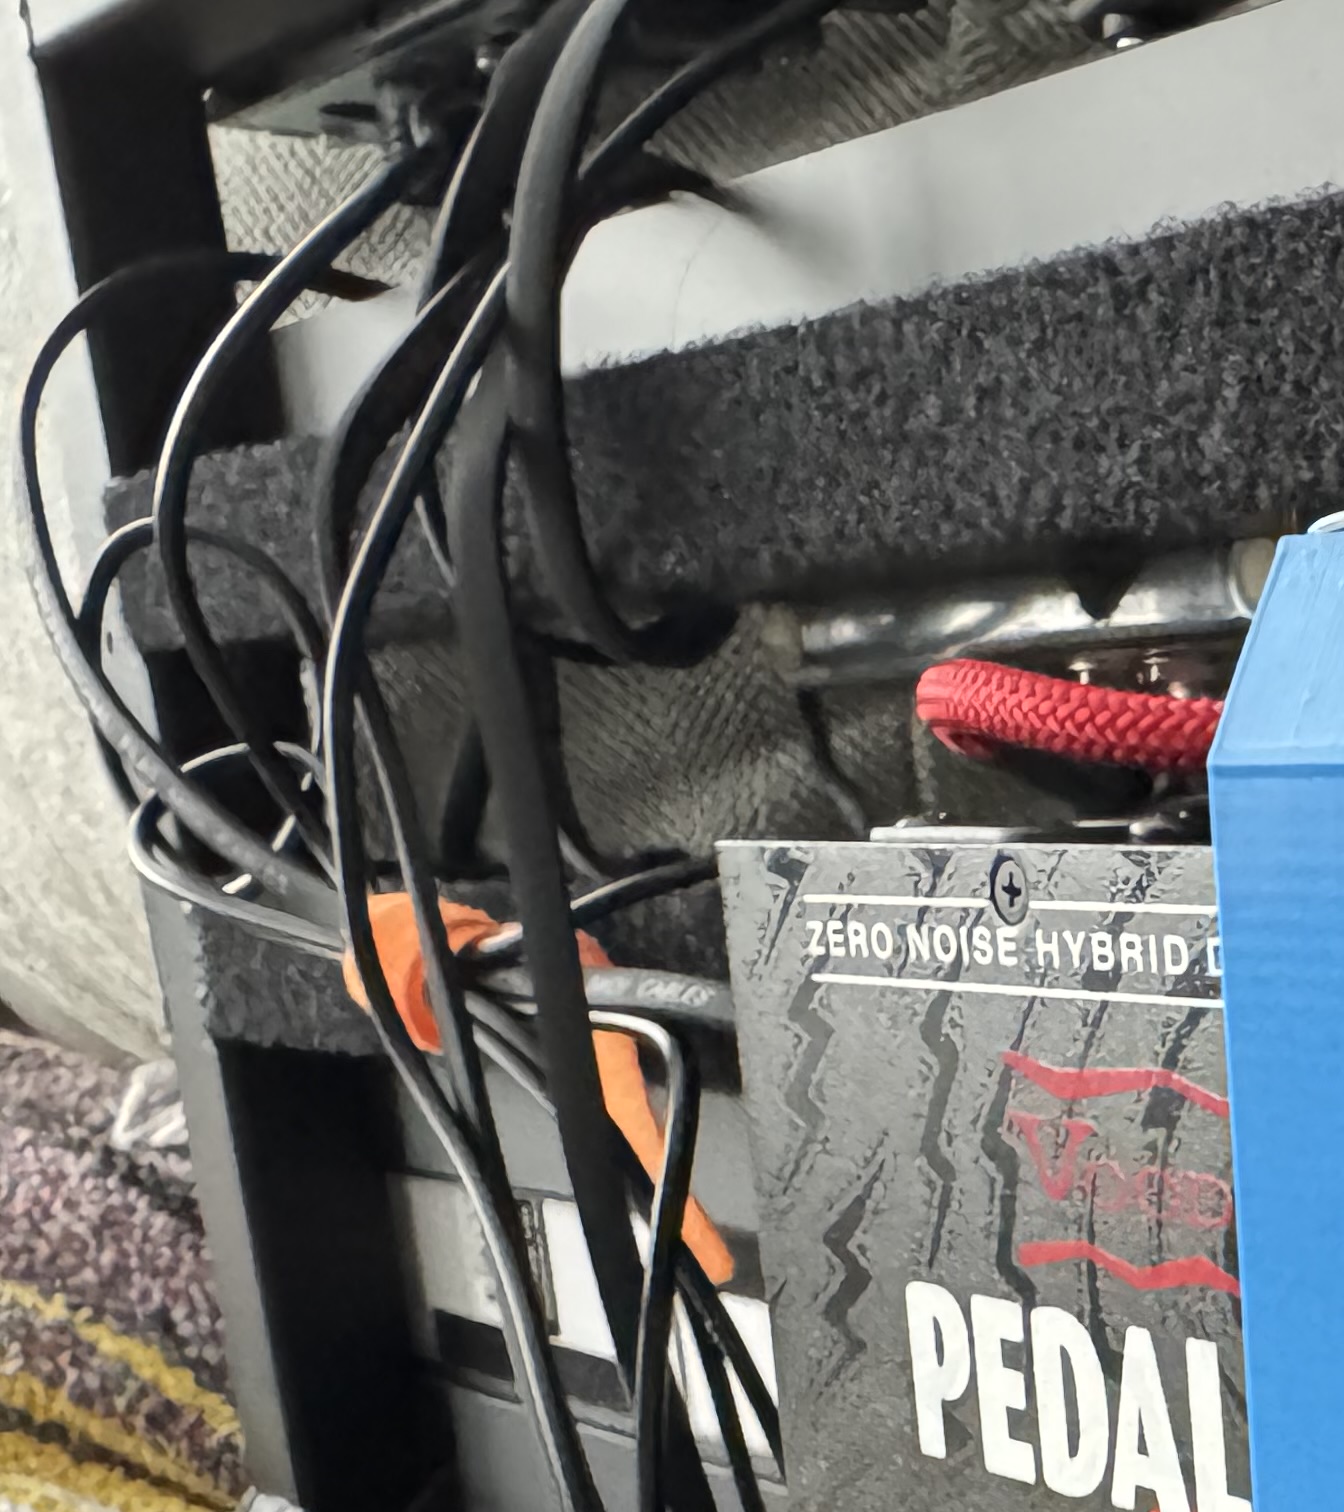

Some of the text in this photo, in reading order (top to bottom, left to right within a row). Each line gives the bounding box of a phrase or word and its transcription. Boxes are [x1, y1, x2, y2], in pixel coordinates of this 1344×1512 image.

[805, 920, 894, 960] ZERO
[905, 923, 1019, 969] NOISE
[1035, 928, 1189, 975] HYBRID
